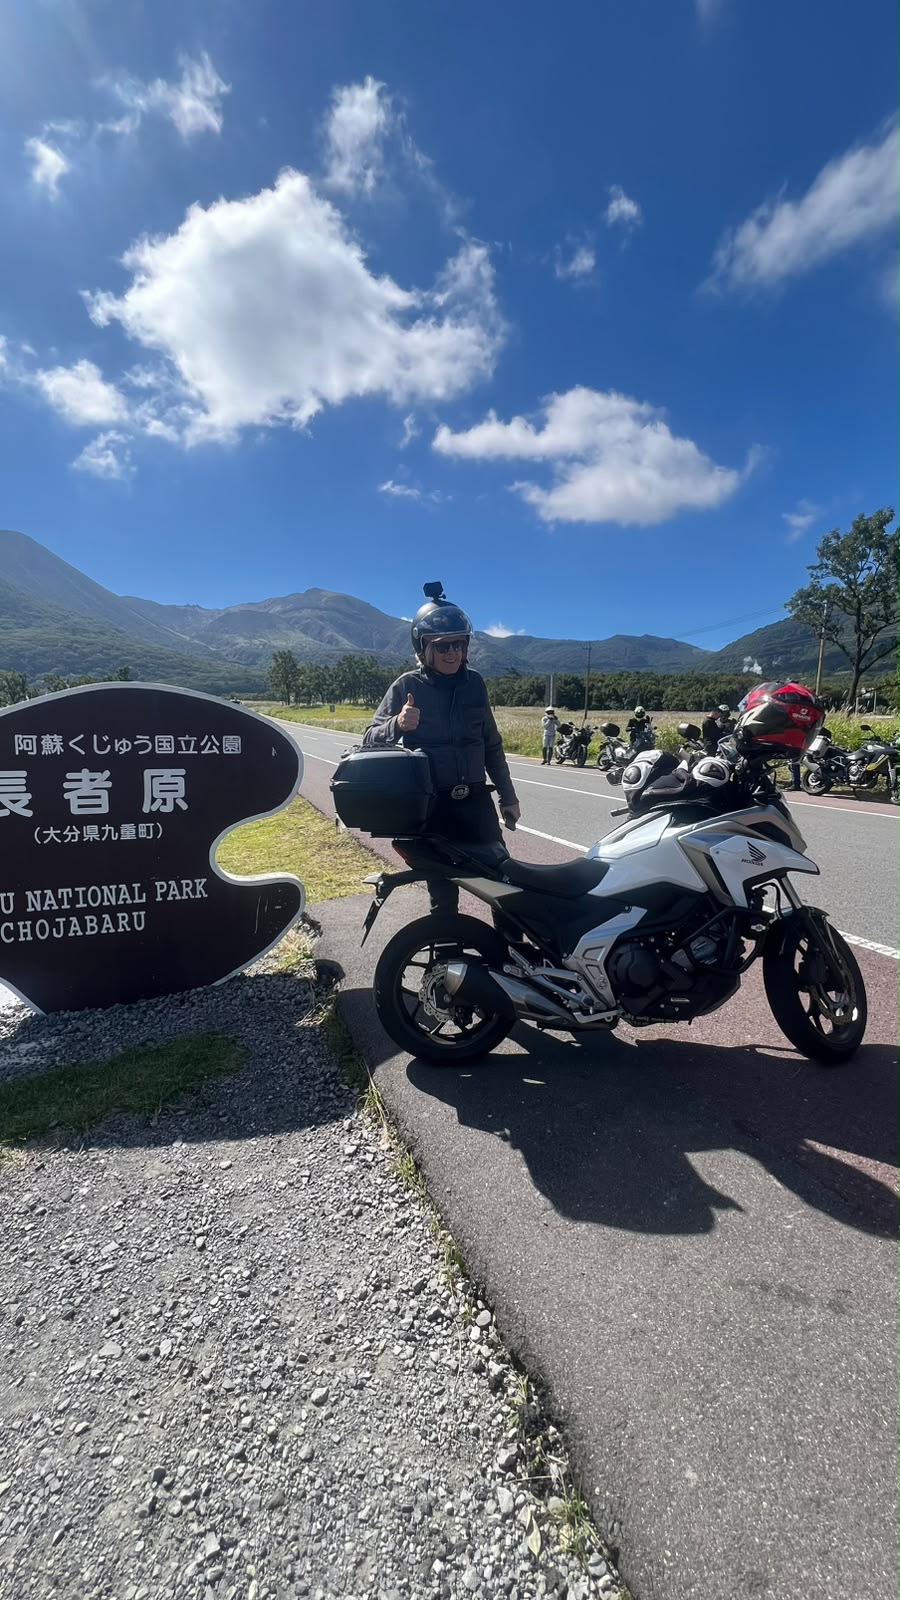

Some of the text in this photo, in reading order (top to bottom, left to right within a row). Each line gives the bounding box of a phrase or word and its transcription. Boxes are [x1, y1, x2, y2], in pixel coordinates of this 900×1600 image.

[14, 733, 242, 756] 阿蘇くじゅう国立公園
[0, 768, 189, 818] 長者原
[25, 883, 146, 912] NATIONAL
[154, 878, 209, 902] PARK
[0, 911, 146, 944] CHOJABARU
